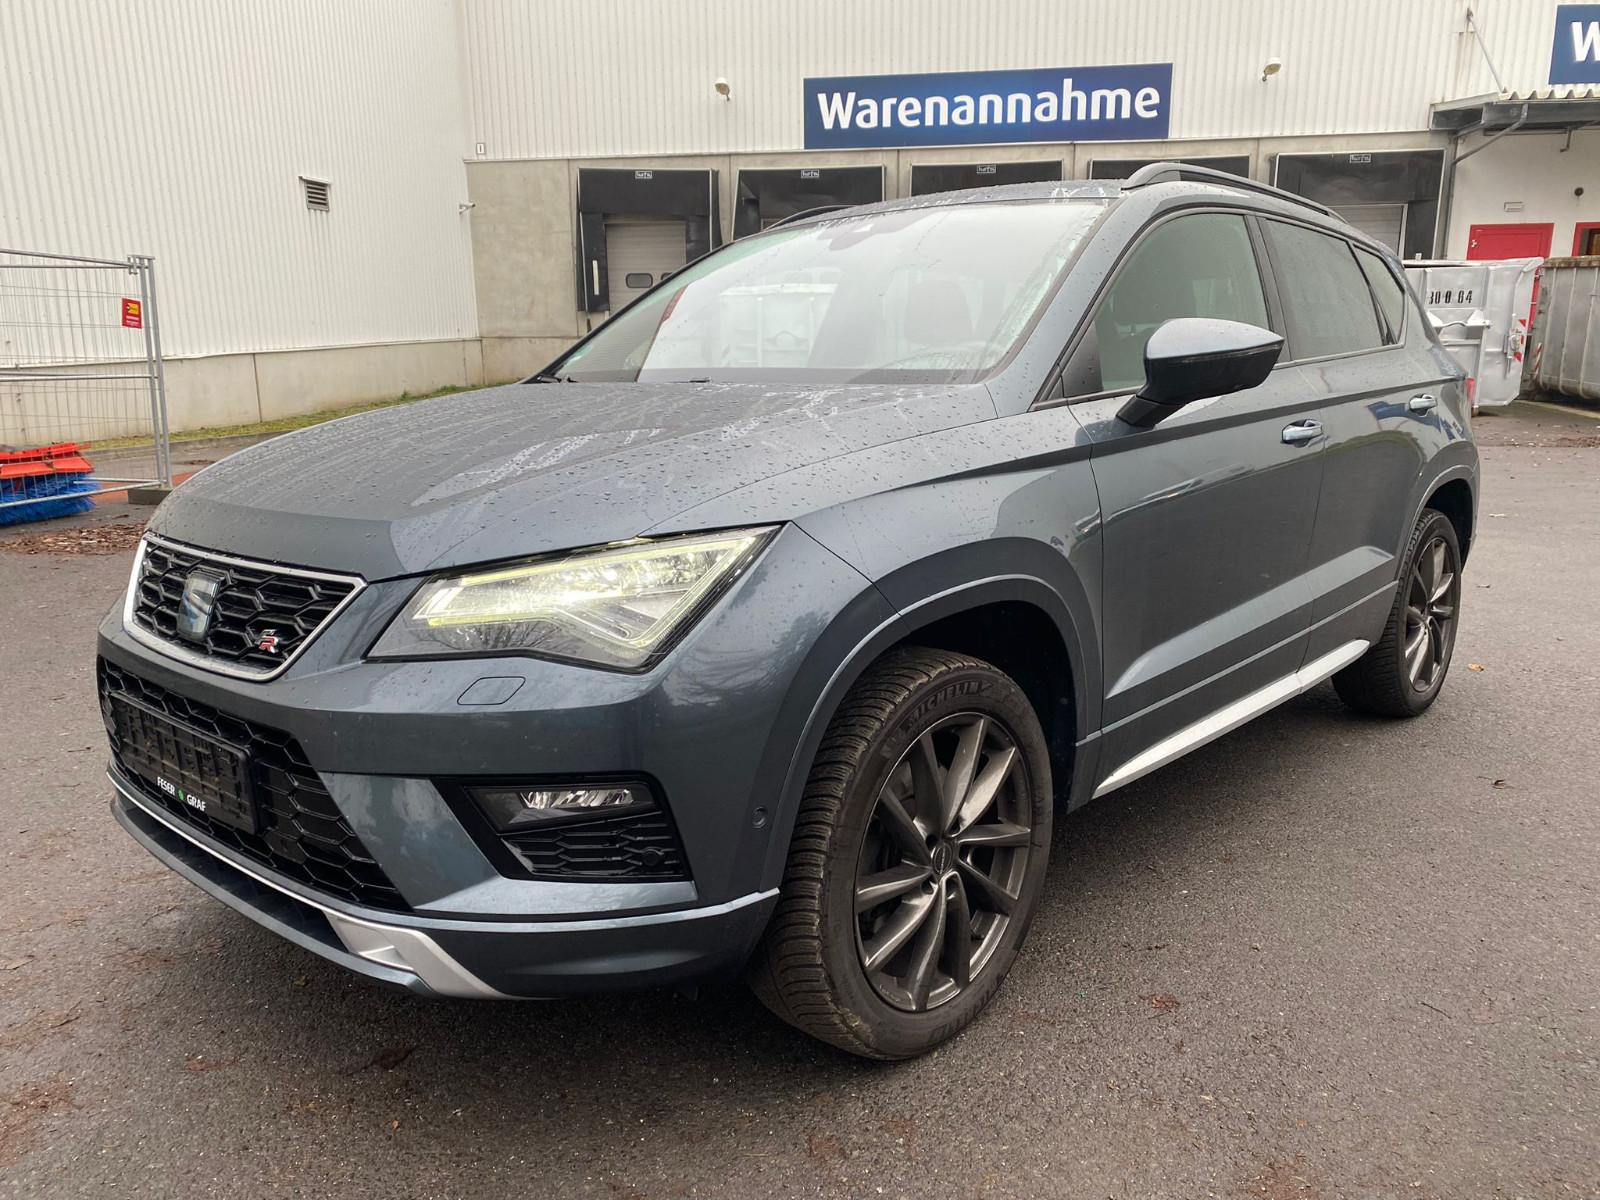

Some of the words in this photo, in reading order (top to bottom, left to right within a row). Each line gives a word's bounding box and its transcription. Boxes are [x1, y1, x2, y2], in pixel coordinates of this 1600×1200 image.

[817, 78, 1161, 130] Warenannahme
[157, 776, 175, 796] FESER
[186, 794, 206, 812] GRAF
